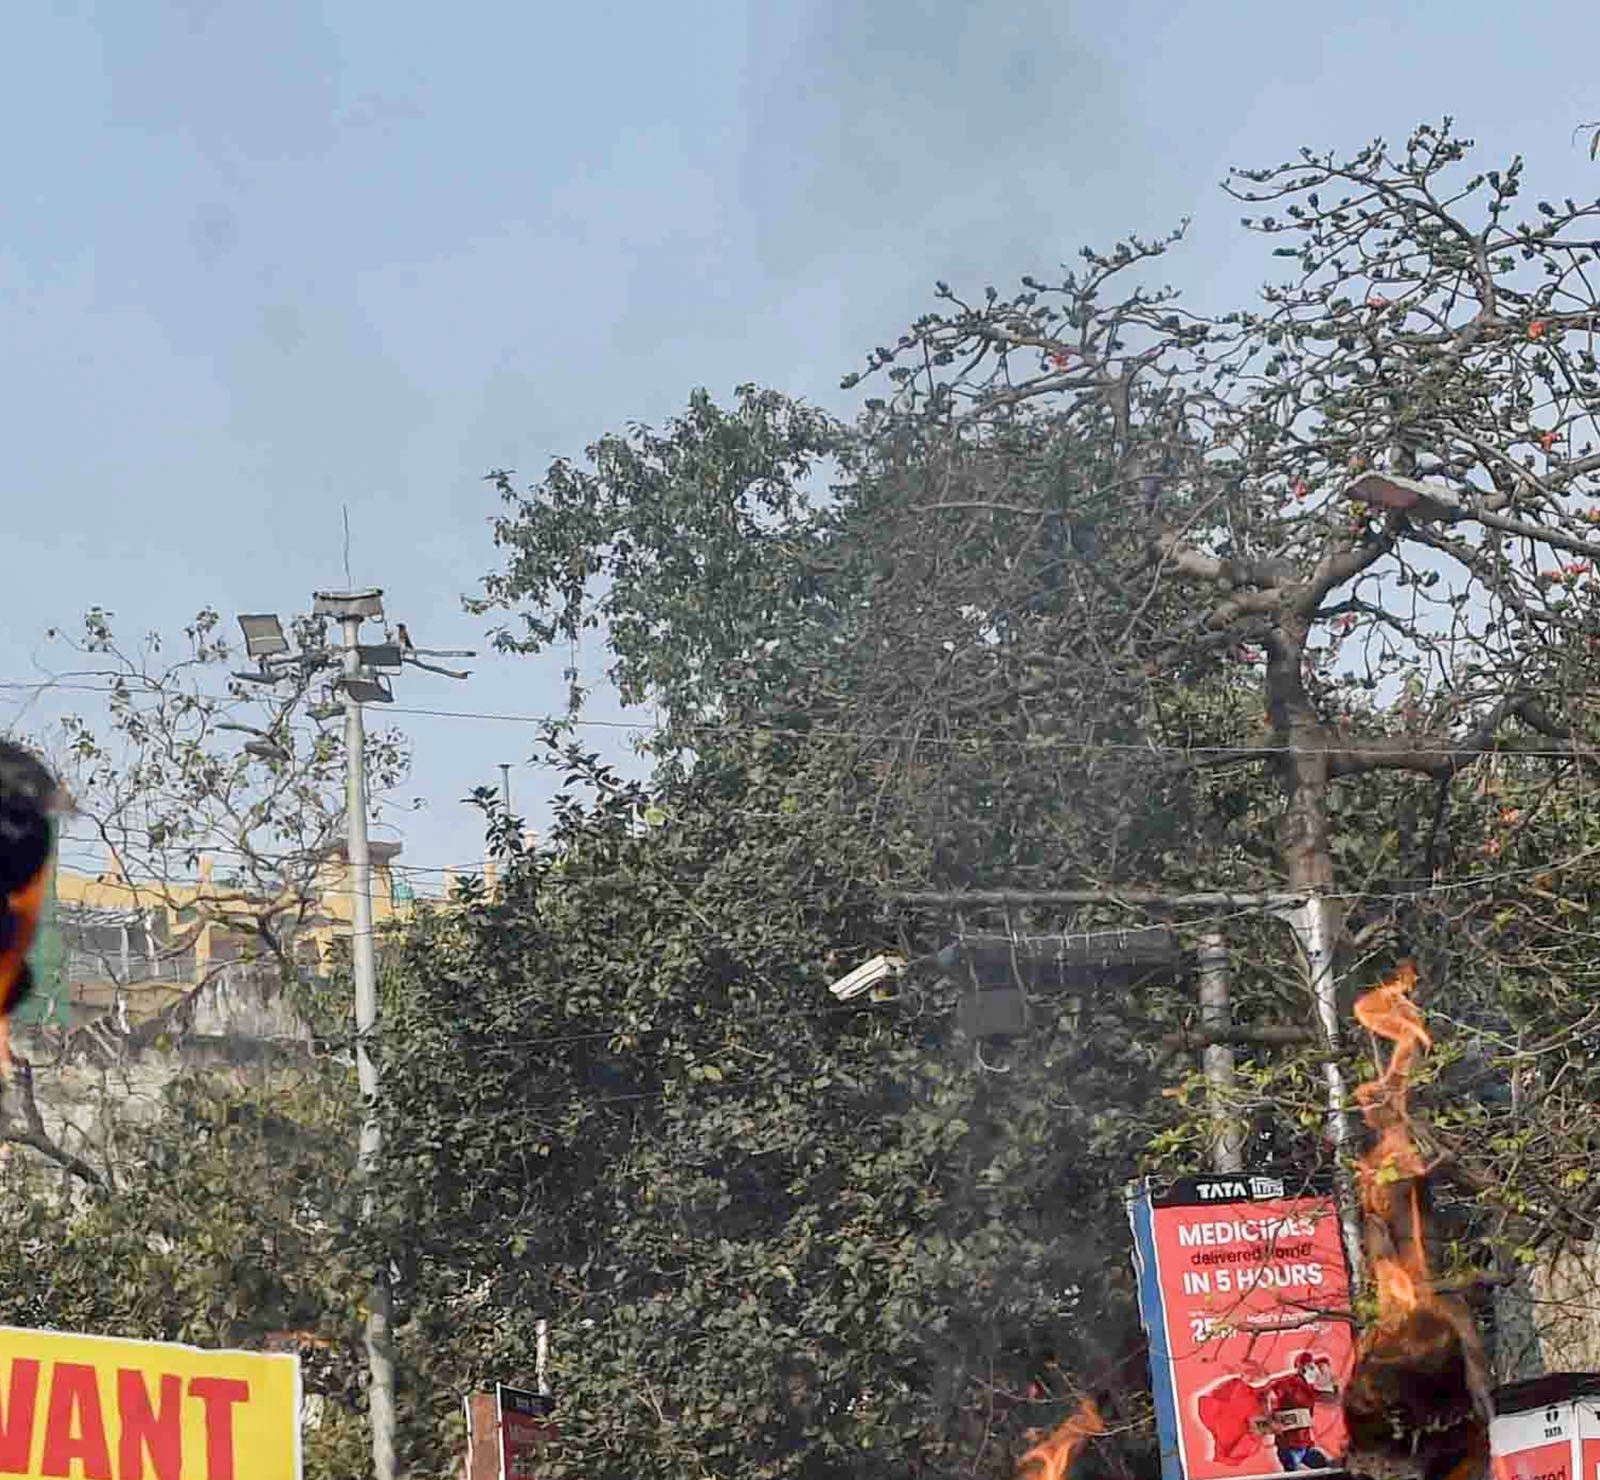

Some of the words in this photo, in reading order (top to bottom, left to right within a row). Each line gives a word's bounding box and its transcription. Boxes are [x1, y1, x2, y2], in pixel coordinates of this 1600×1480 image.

[1197, 1182, 1246, 1199] TATA
[1179, 1217, 1315, 1246] MEDICINES
[1183, 1272, 1210, 1294] IN
[1216, 1270, 1230, 1291] 5
[1237, 1262, 1324, 1290] HOURS
